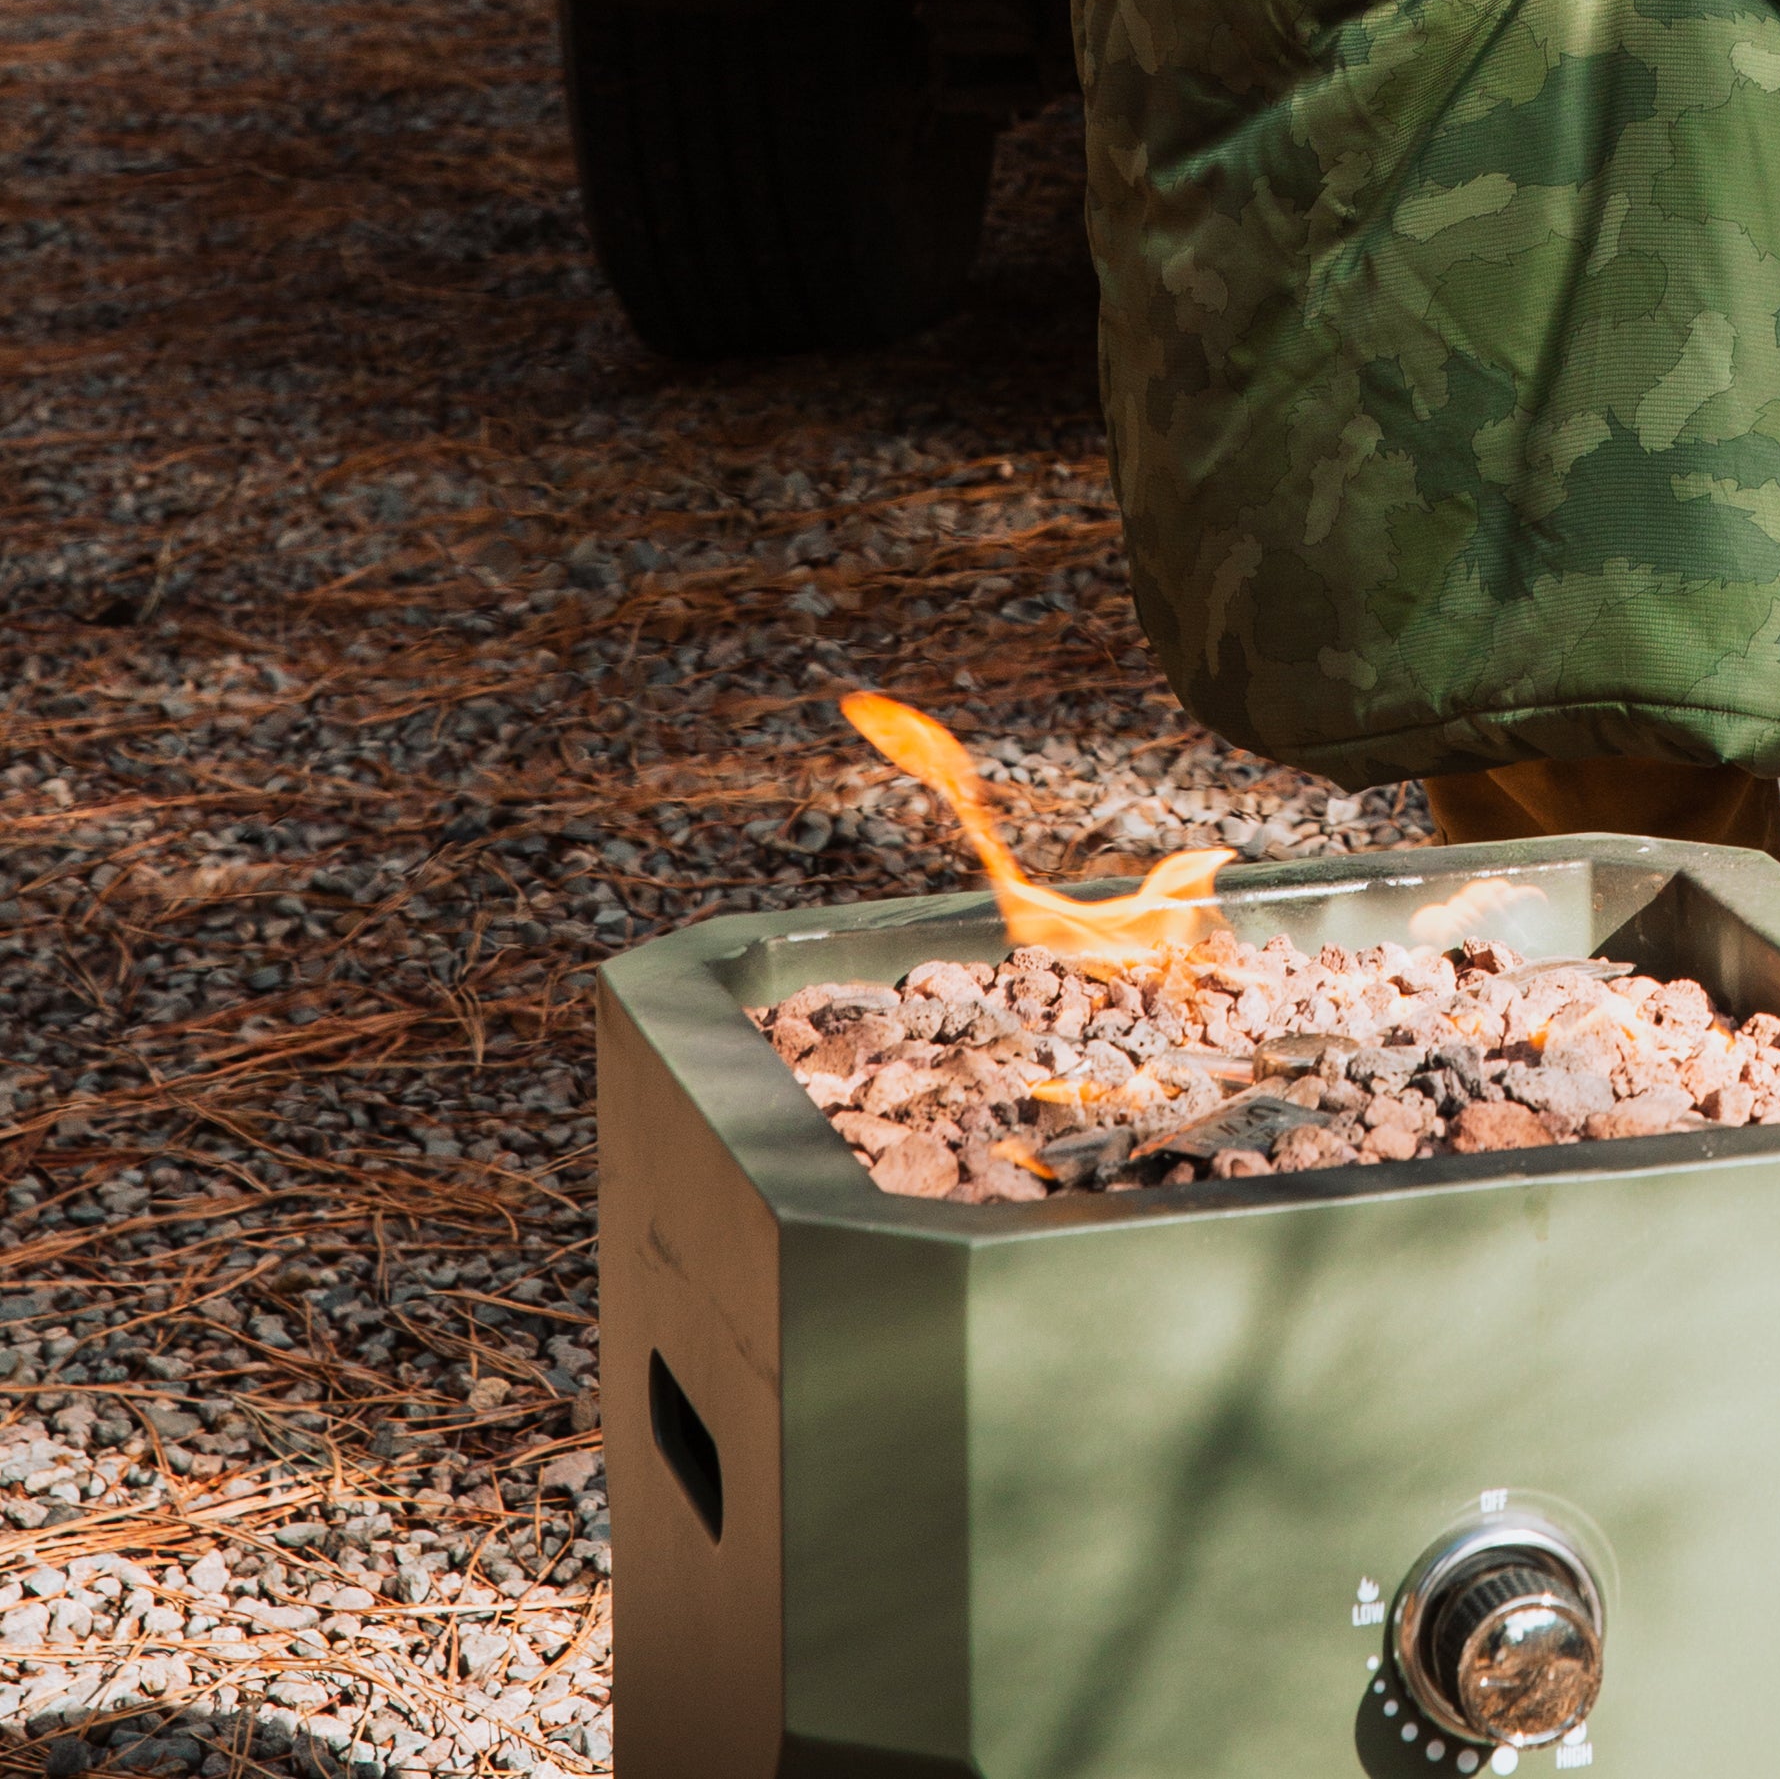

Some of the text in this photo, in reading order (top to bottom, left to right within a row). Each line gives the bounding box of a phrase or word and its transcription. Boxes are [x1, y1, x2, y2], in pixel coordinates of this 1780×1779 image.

[1480, 1488, 1508, 1513] OFF
[1352, 1601, 1385, 1627] LOW
[1556, 1742, 1593, 1770] HIGH
